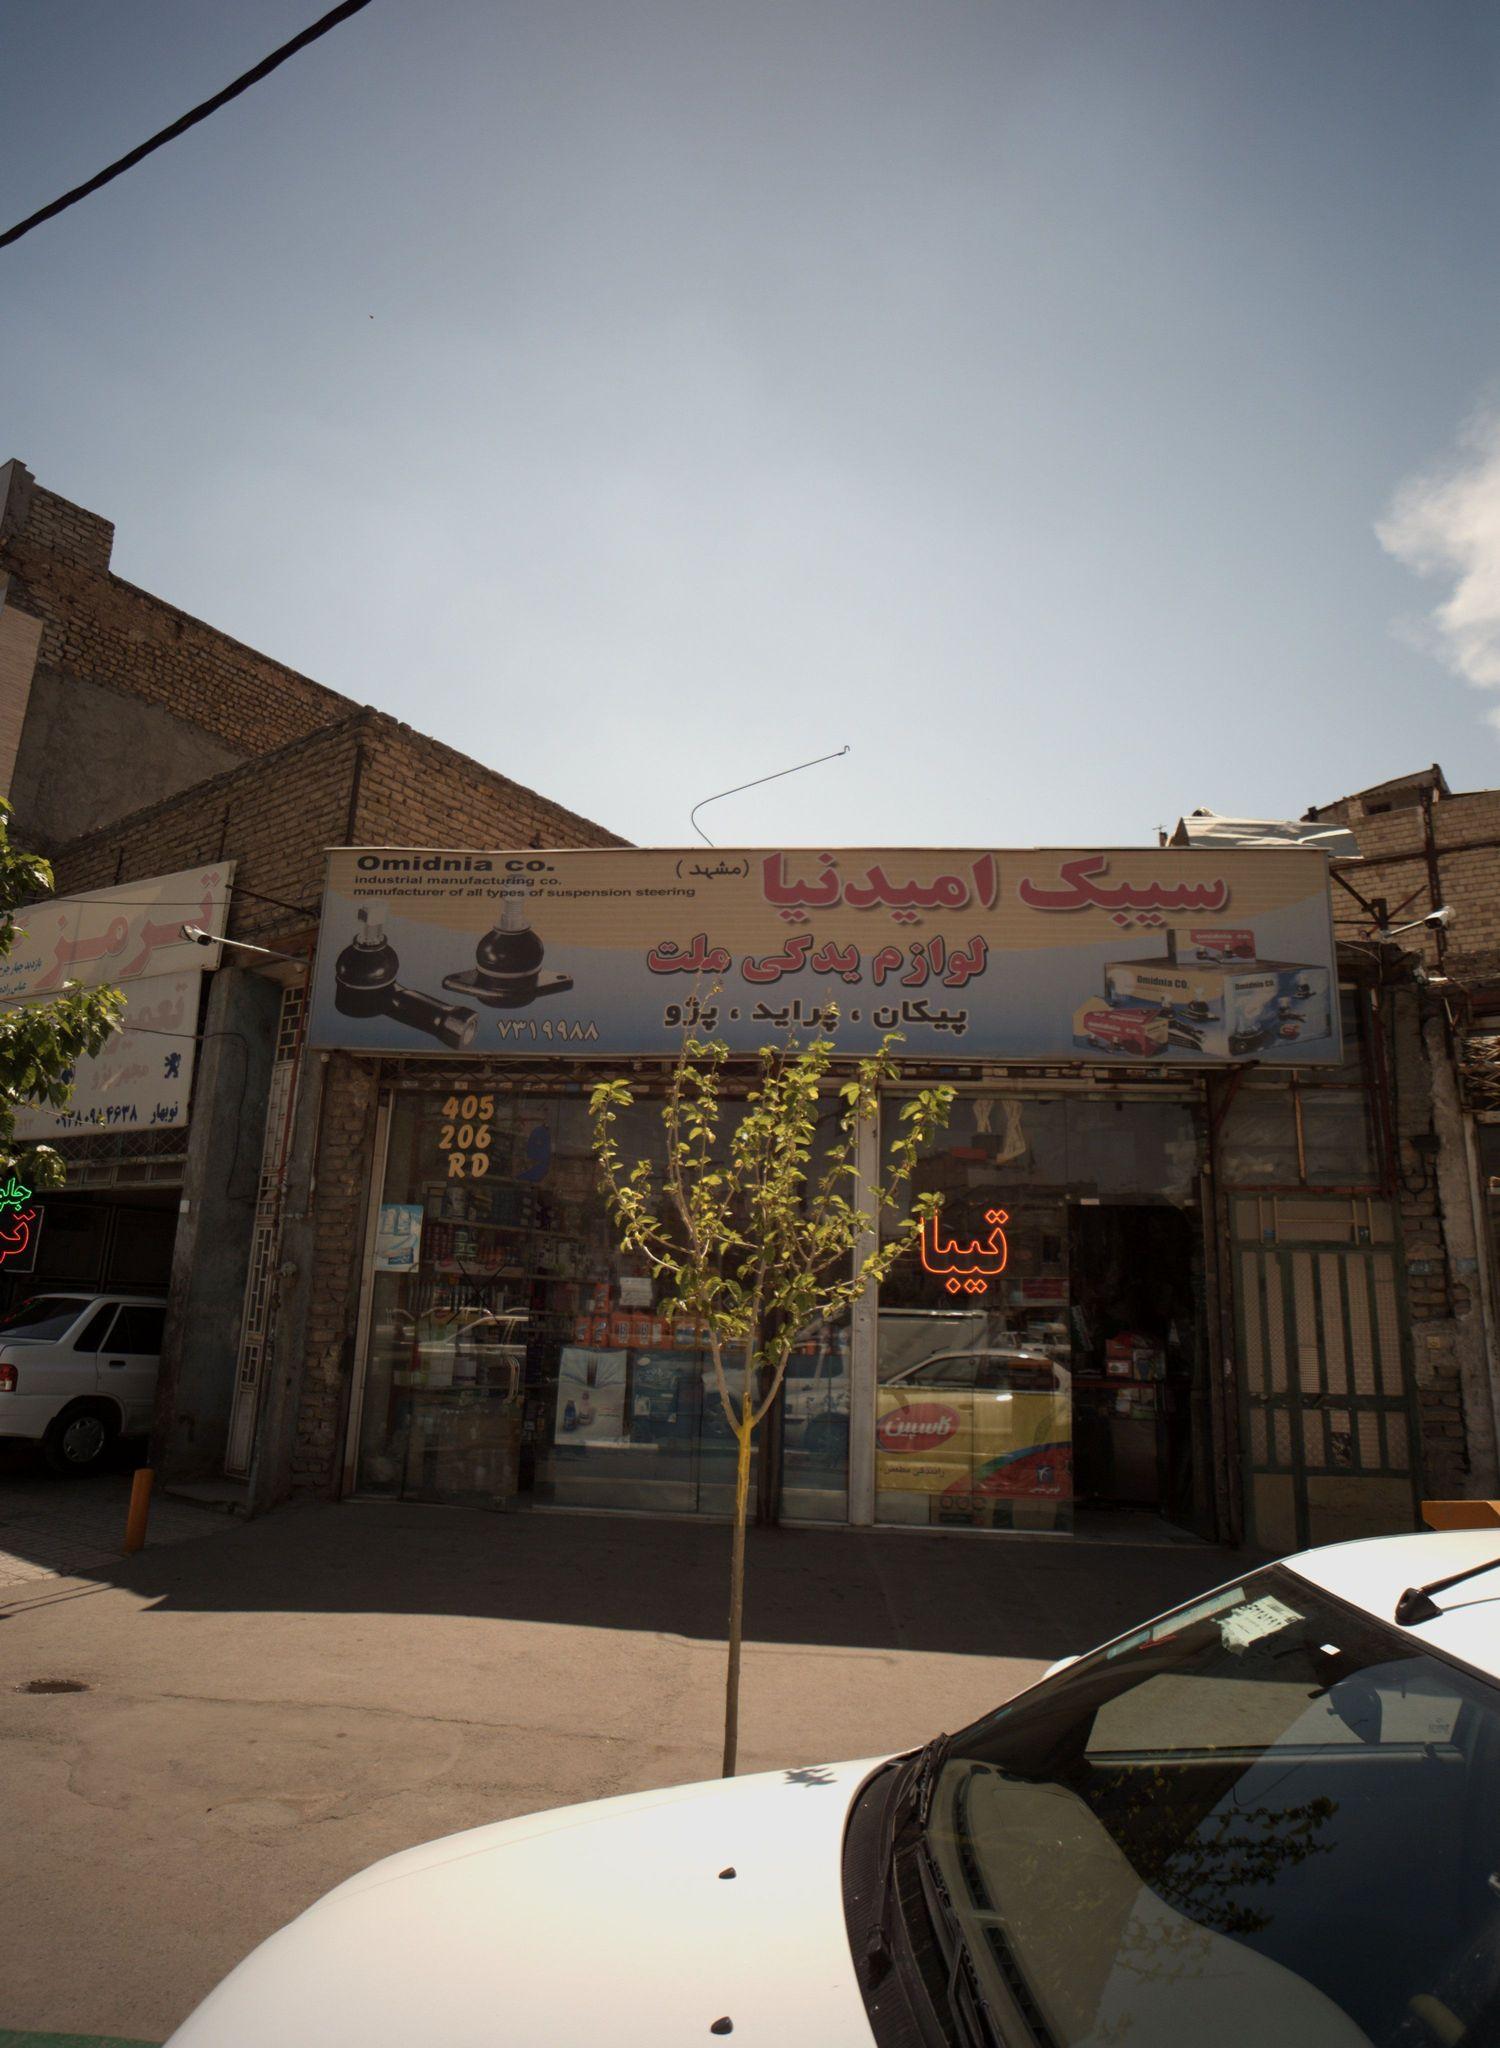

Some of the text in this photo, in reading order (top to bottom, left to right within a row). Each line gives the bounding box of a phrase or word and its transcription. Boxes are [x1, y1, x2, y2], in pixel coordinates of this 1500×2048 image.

[357, 855, 555, 873] Omidnia co.
[353, 887, 696, 900] manufacturer of all types of suspension steering
[354, 875, 562, 887] industrial manufacturing co.
[762, 852, 997, 922] امیدنیا
[1019, 854, 1229, 927] سیبک
[647, 933, 989, 986] لوازم یدکی ملت
[664, 998, 718, 1031] پژو
[752, 1000, 840, 1031] پراید
[872, 1000, 968, 1034] پیکان
[497, 1019, 599, 1041] ۷۳۱۹۹۸۸
[441, 1095, 495, 1120] 405
[439, 1124, 492, 1149] 206
[921, 1207, 1009, 1294] تیبا
[884, 1416, 952, 1439] کاسپین
